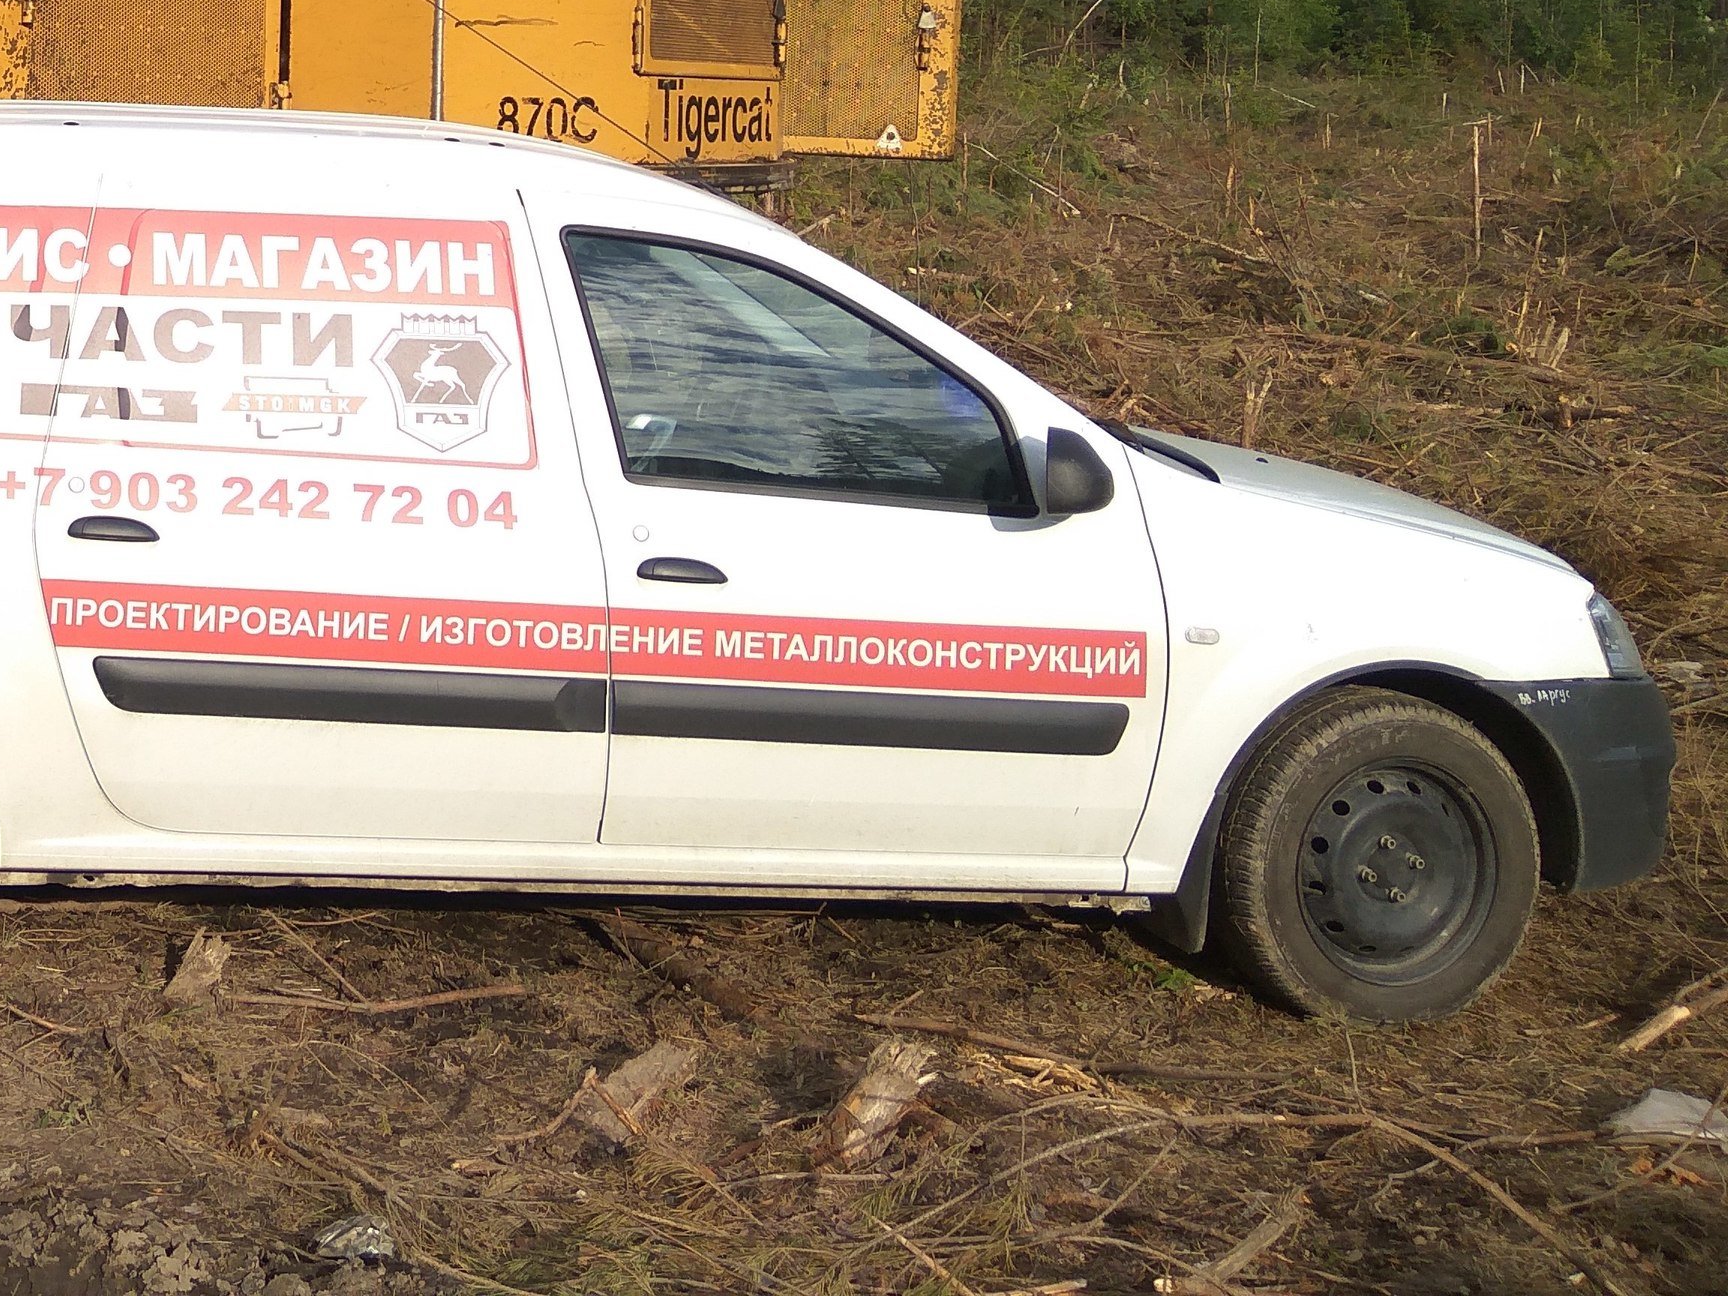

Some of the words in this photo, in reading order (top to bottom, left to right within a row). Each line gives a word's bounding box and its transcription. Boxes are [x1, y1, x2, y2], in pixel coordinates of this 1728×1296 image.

[498, 96, 598, 143] 870C
[657, 79, 772, 158] Tigercat
[152, 232, 495, 296] МАГАЗИН
[416, 412, 469, 425] ГАЗ
[90, 470, 198, 513] 903
[222, 477, 330, 520] 242
[353, 483, 424, 525] 72
[447, 488, 518, 530] 04
[51, 597, 389, 642] ПРОЕКТИРОВАНИЕ
[420, 616, 703, 657] ИЗГОТОВЛЕНИЕ
[715, 630, 1141, 678] МЕТАЛЛОКОНСТРУКЦИЙ
